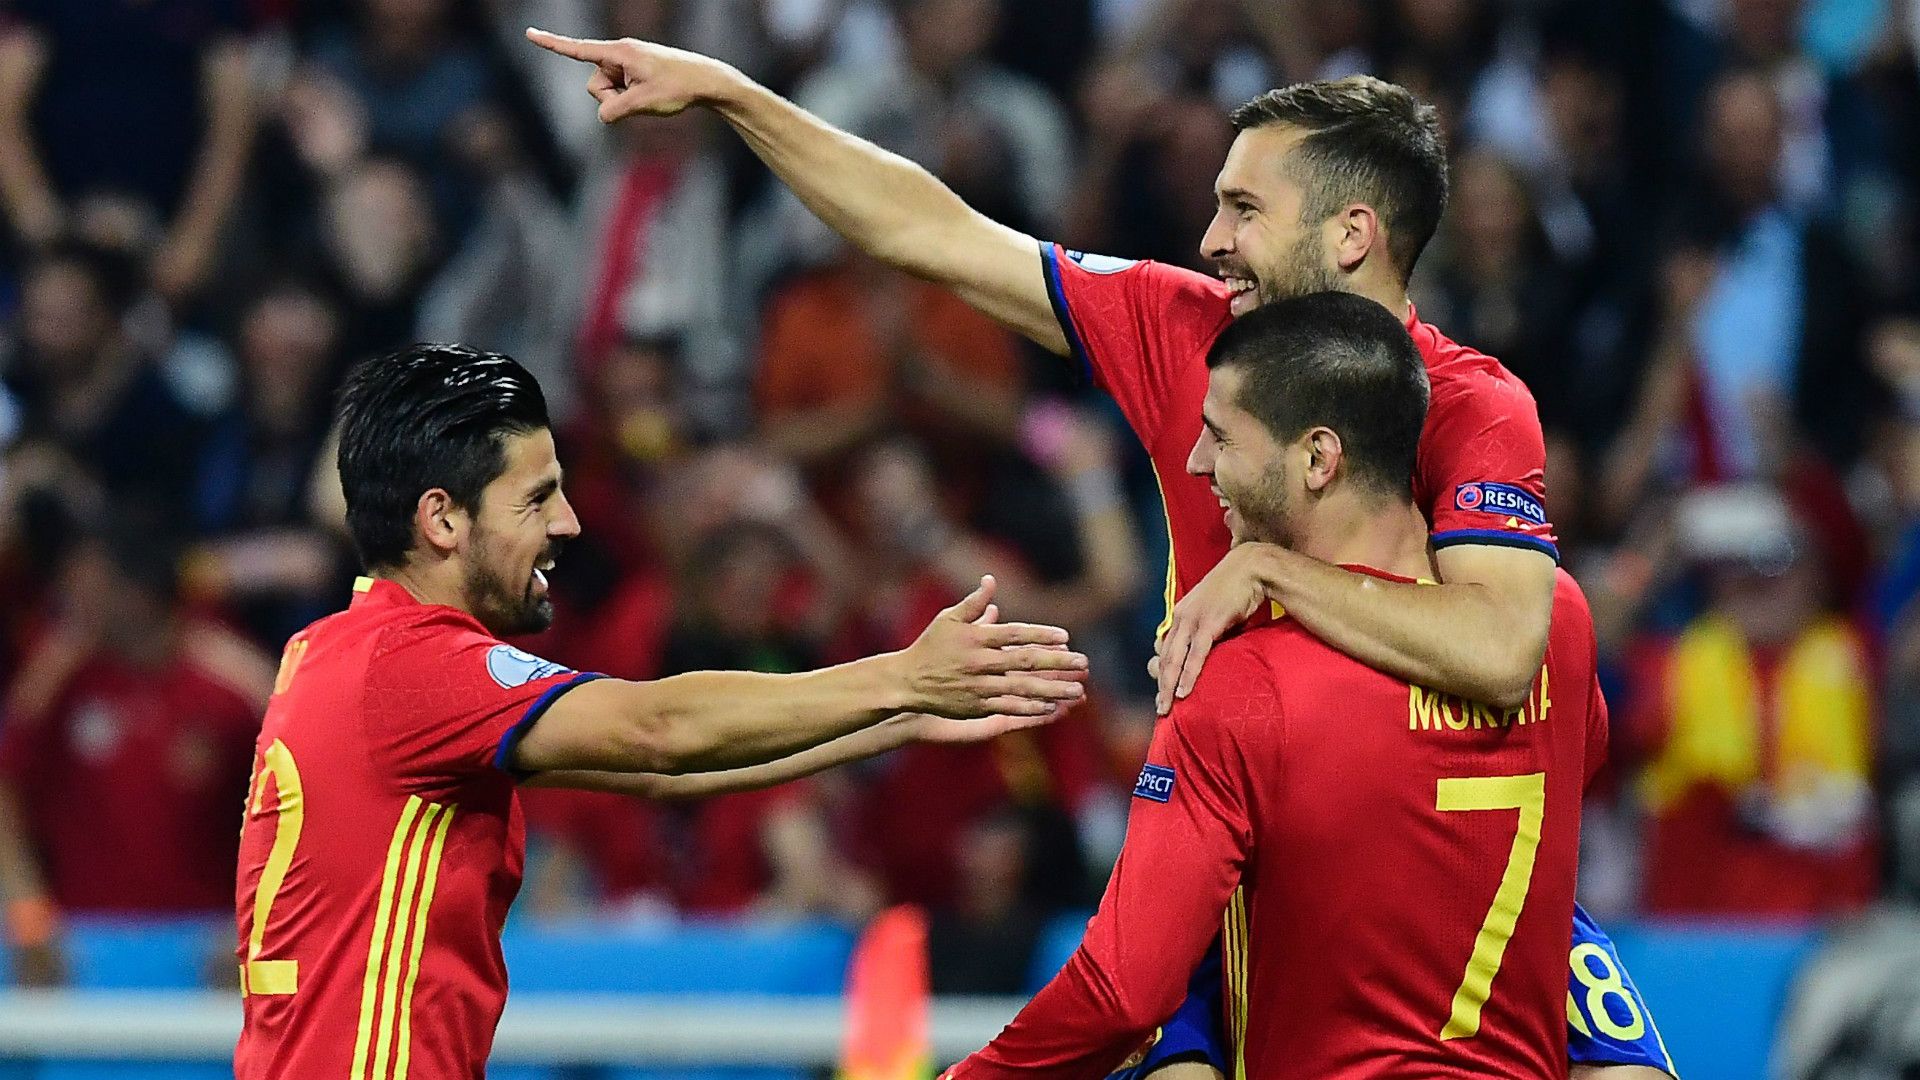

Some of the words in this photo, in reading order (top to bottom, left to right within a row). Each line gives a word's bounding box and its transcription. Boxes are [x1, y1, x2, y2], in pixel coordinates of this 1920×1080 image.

[1485, 490, 1544, 523] RESPECT
[238, 737, 305, 998] 2
[1436, 772, 1545, 1041] 7
[1566, 942, 1645, 1041] 8
